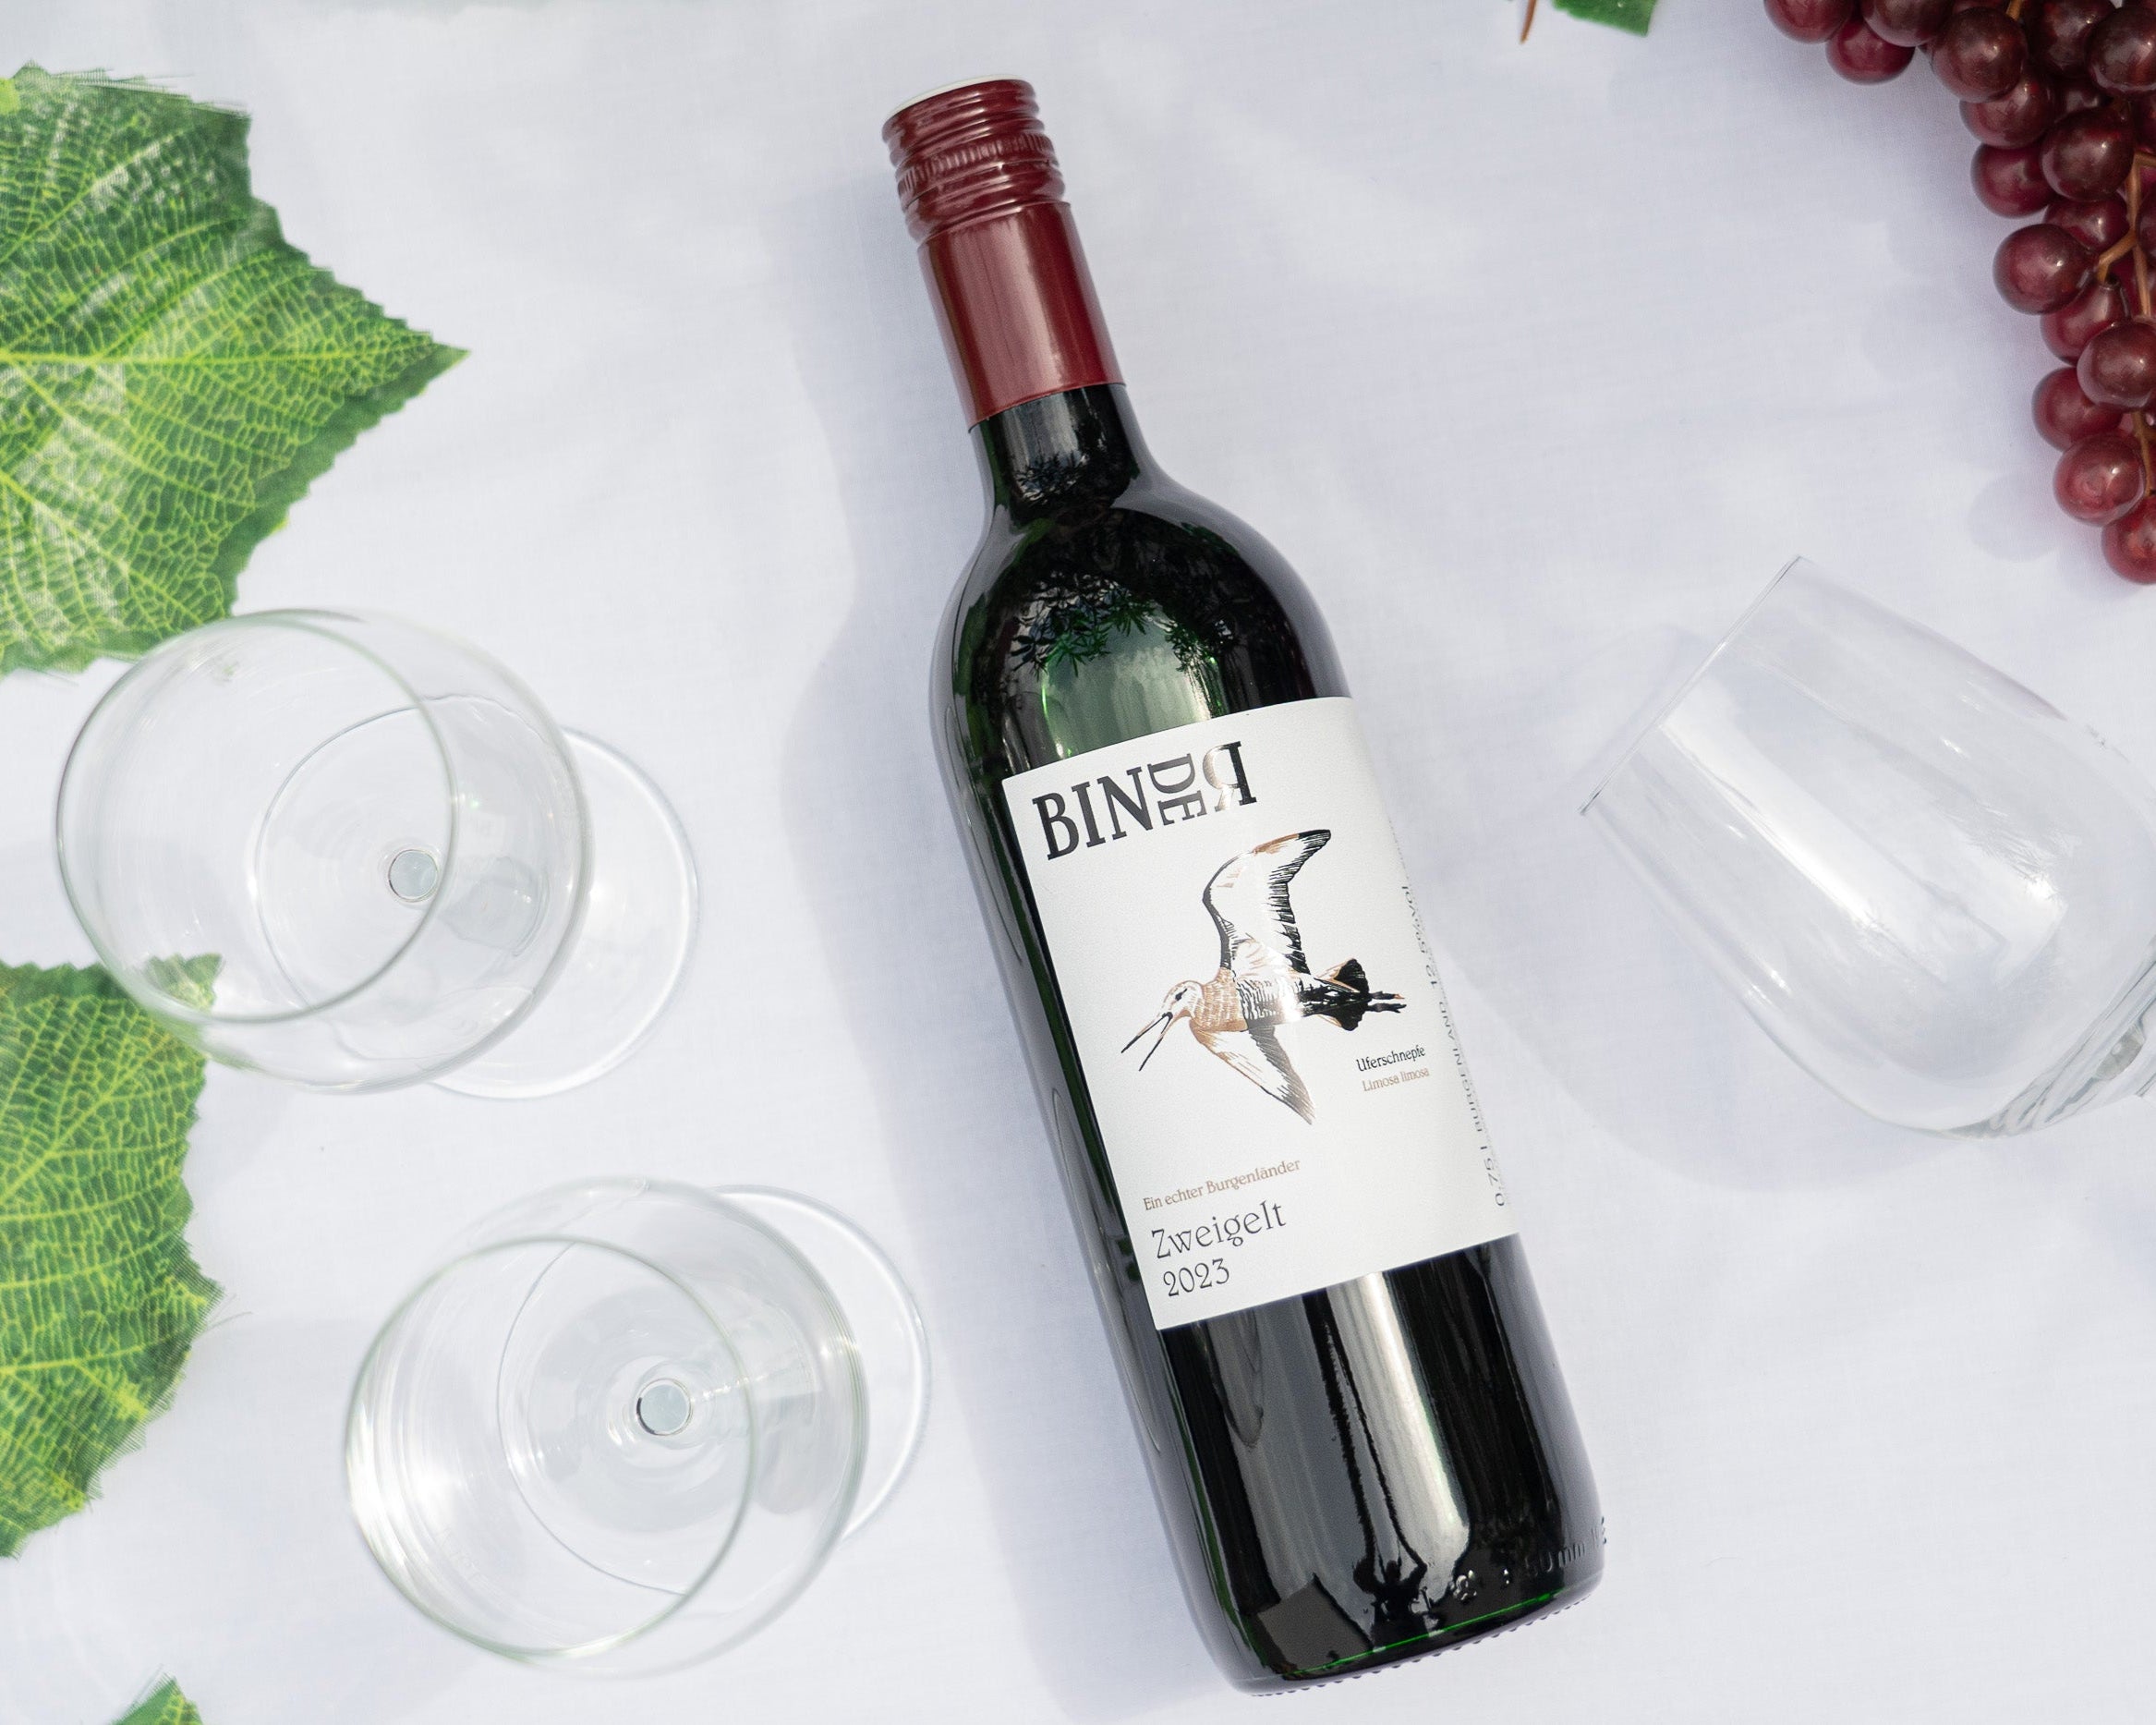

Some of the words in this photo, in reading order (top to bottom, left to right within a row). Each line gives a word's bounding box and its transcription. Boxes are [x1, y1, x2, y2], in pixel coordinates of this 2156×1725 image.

[1355, 1044, 1426, 1073] Uferschnepfe
[1362, 1075, 1399, 1092] Limosa
[1399, 1067, 1430, 1083] limosa
[1143, 1197, 1163, 1211] Ein
[1164, 1185, 1204, 1206] echter
[1205, 1160, 1301, 1195] Burgenländer
[1151, 1199, 1287, 1259] Zweigelt
[1163, 1257, 1229, 1297] 2023
